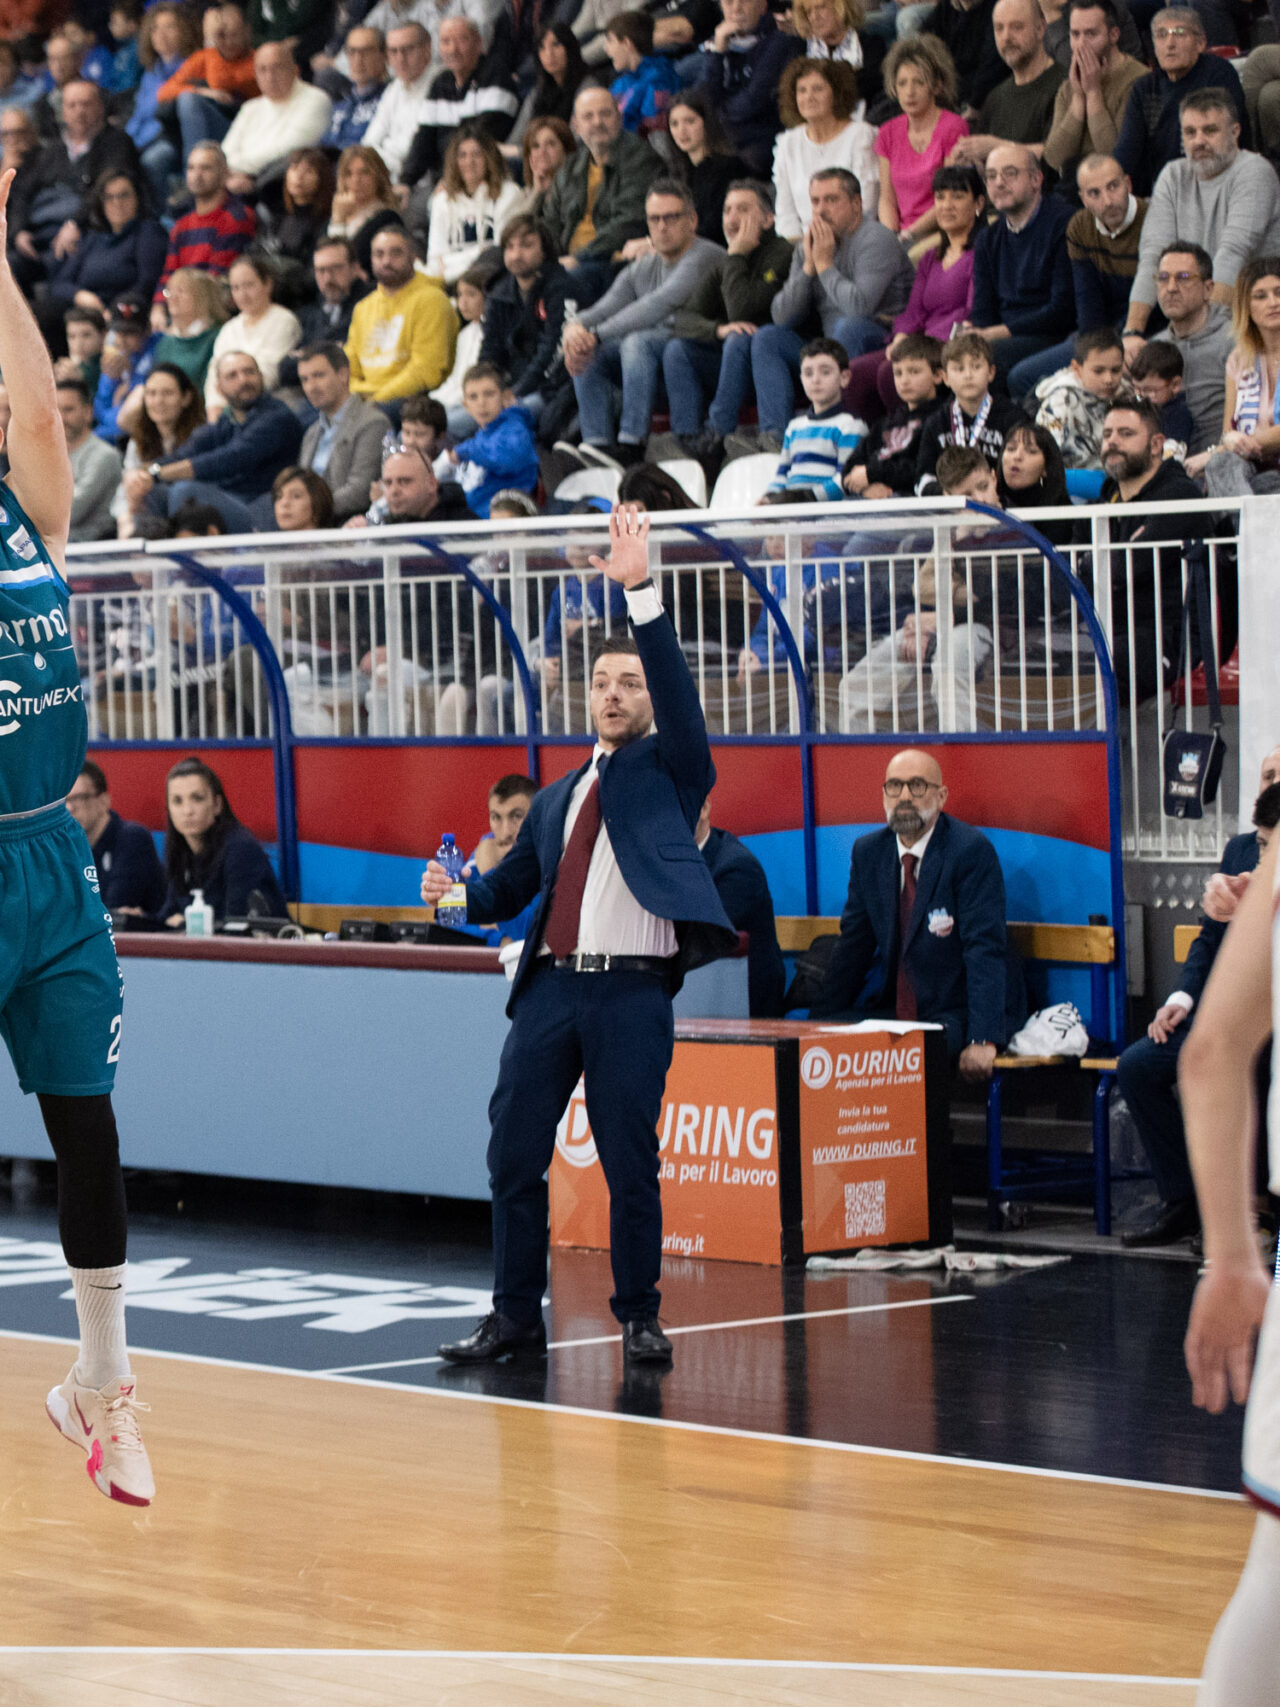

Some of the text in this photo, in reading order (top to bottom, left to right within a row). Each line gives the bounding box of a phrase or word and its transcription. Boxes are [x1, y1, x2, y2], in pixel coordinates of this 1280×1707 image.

[835, 1047, 921, 1078] DURING
[835, 1073, 922, 1092] Agenzia per il Lavoro
[838, 1104, 888, 1118] Invia la tua
[658, 1102, 776, 1160] URING
[837, 1120, 890, 1135] candidatura
[812, 1137, 917, 1164] WWW.DURING.IT
[679, 1163, 707, 1186] per
[709, 1160, 720, 1183] il
[723, 1162, 777, 1187] Lavoro
